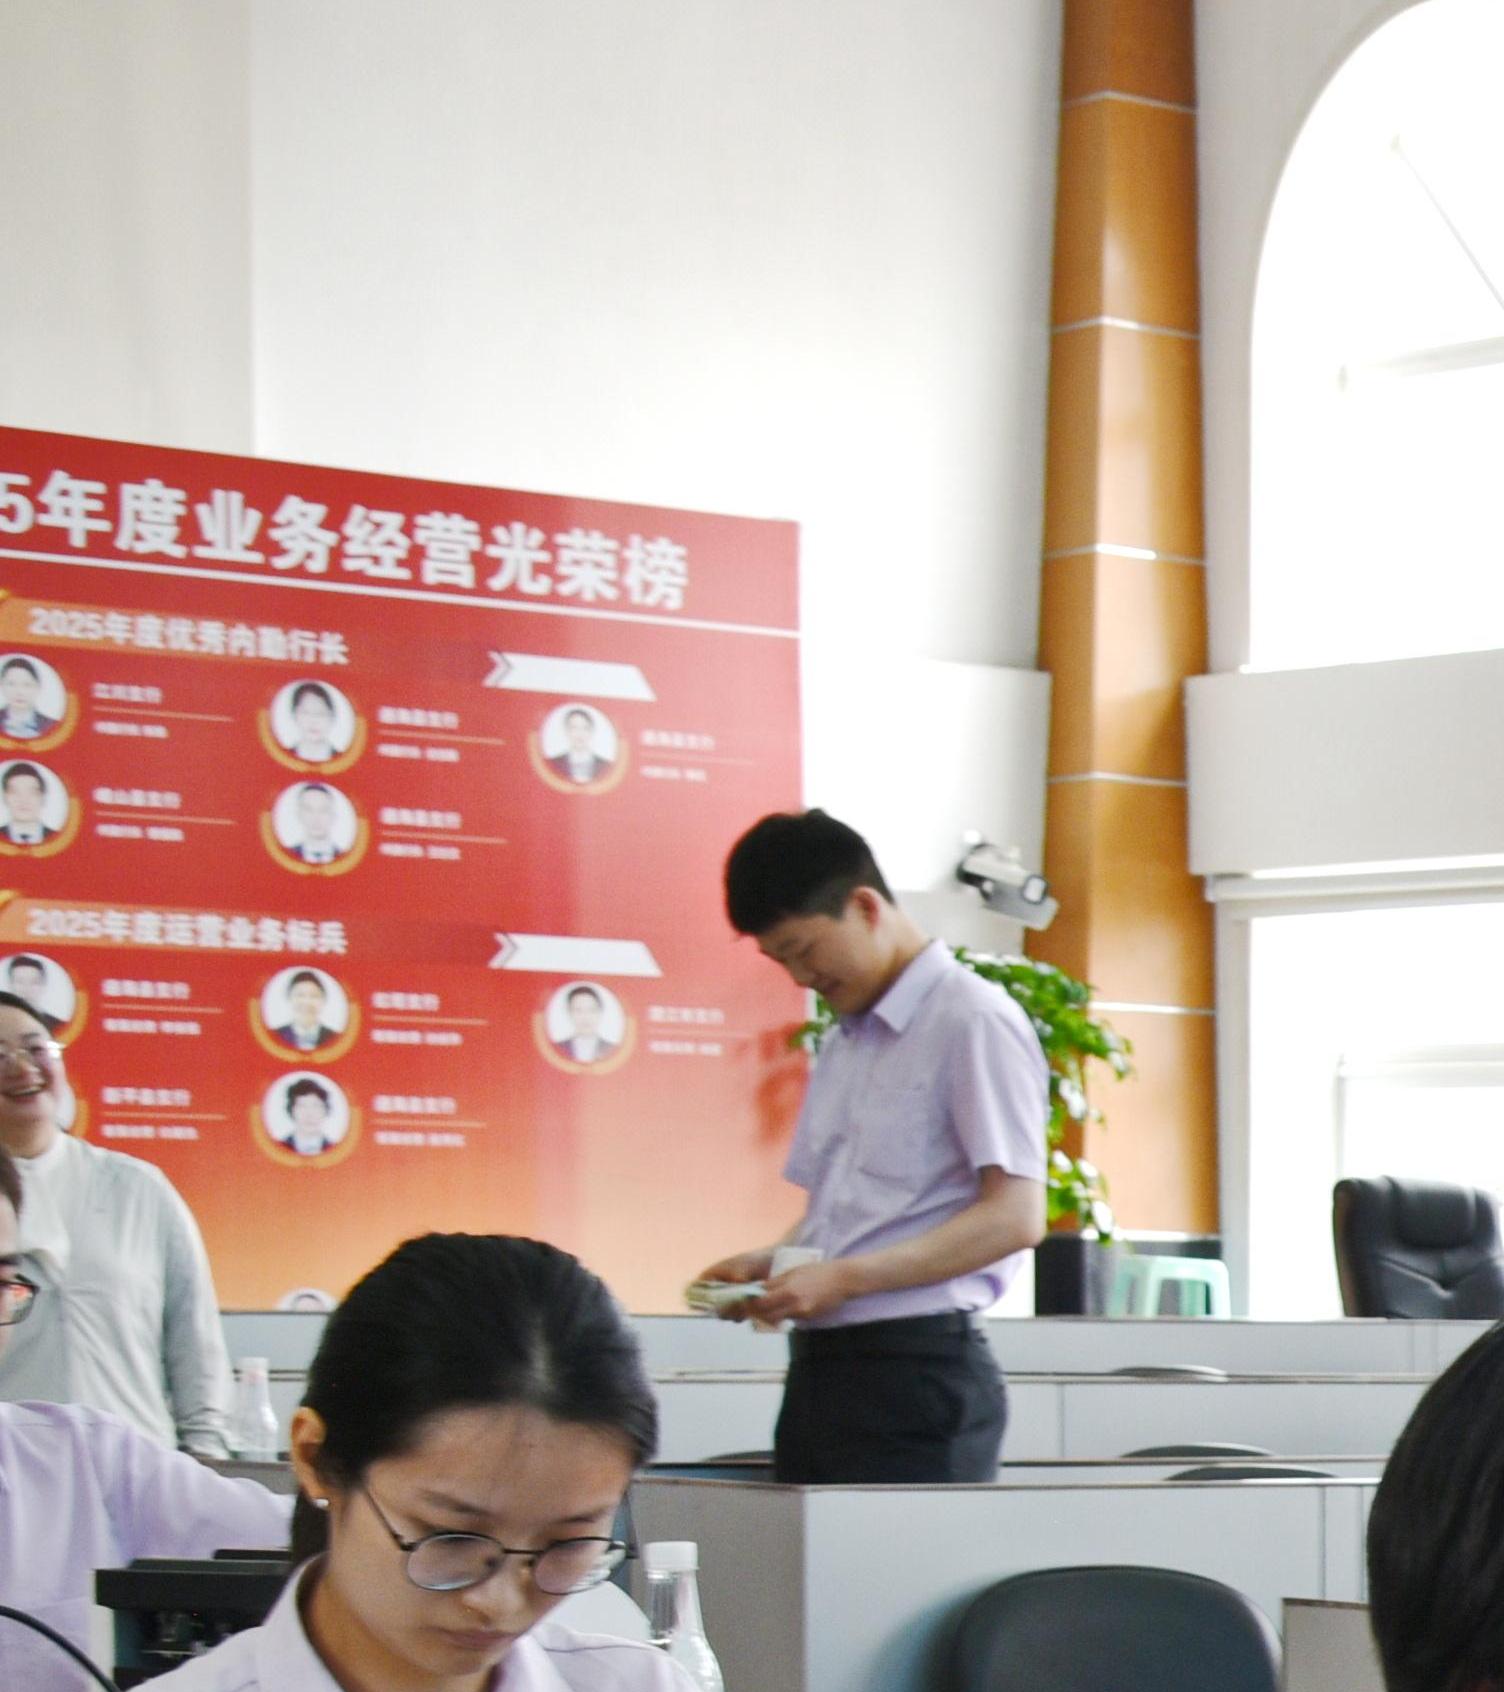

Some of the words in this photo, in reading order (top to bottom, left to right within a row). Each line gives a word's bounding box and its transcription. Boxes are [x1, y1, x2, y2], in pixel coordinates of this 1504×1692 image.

[0, 470, 689, 610] 5年度业务经营光荣榜
